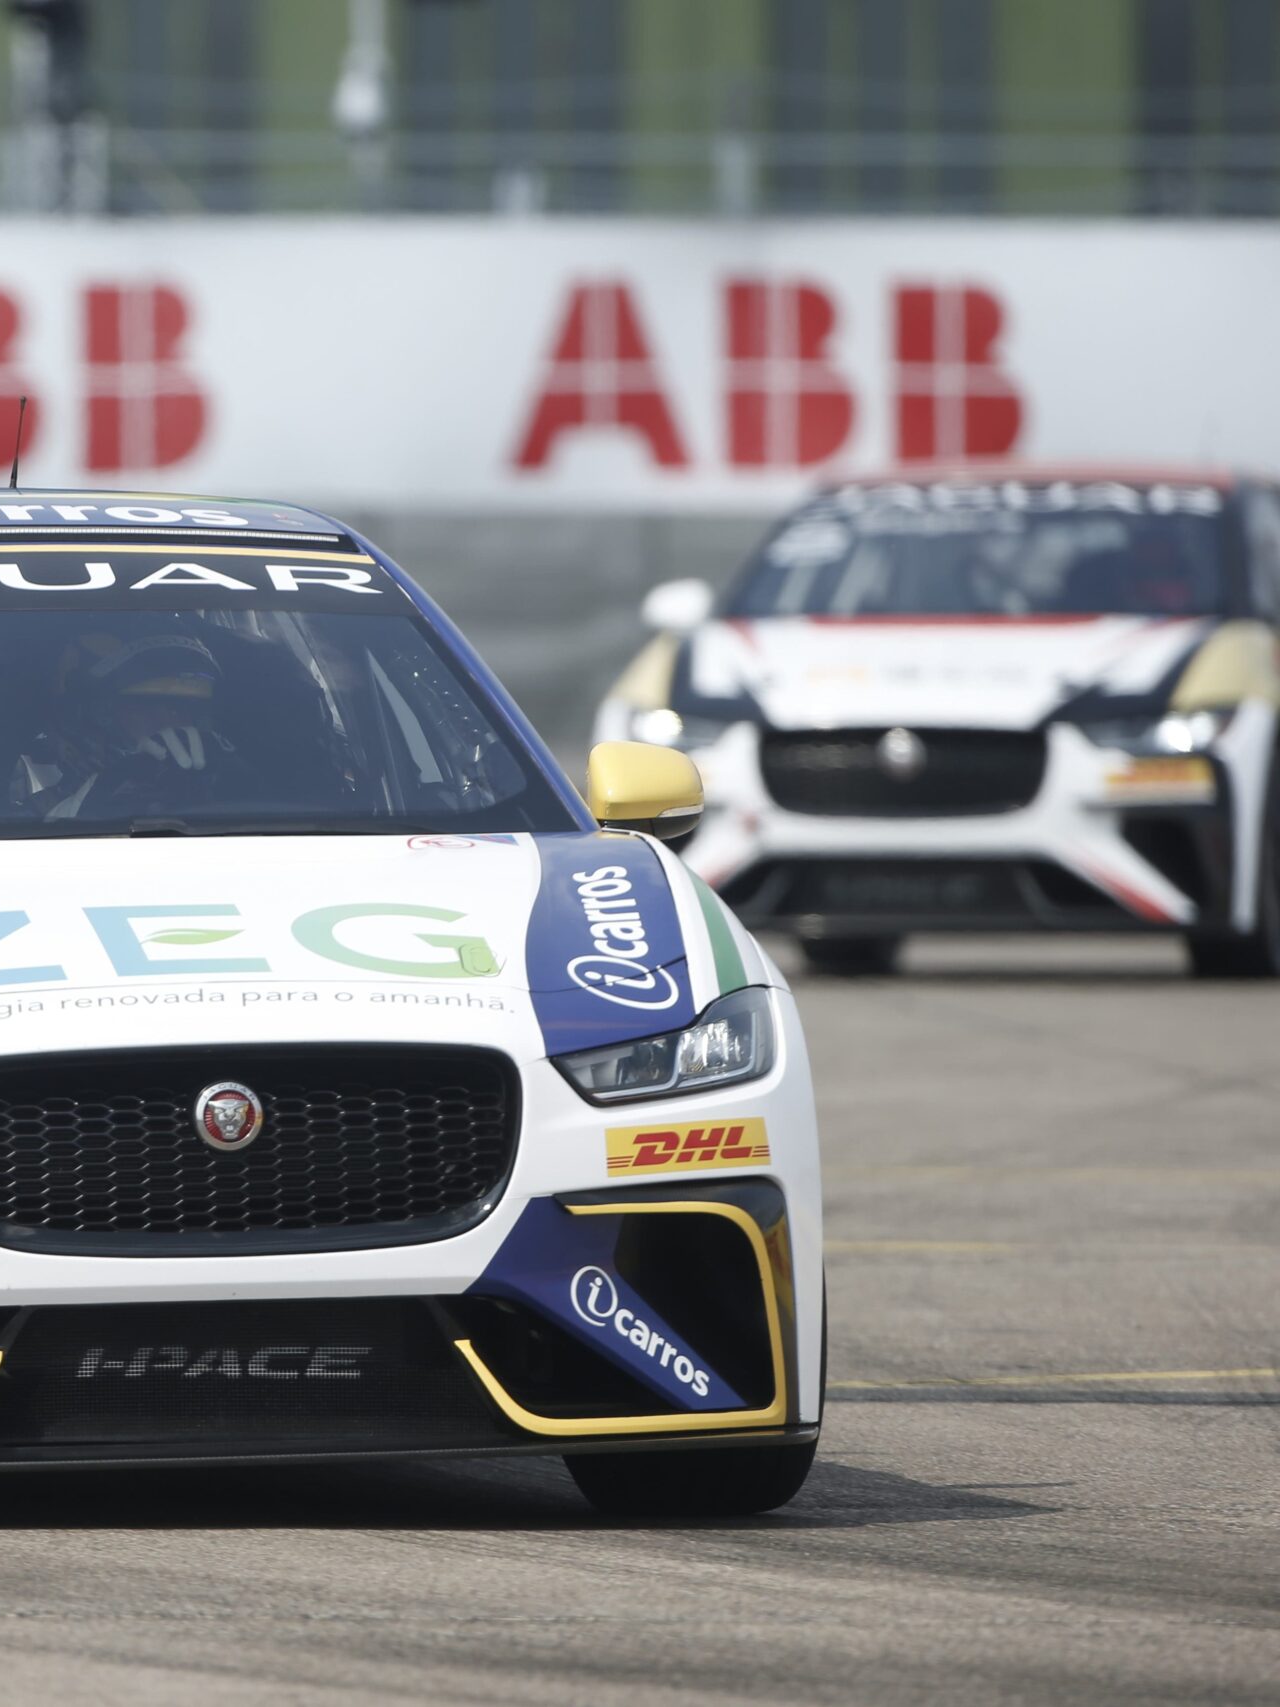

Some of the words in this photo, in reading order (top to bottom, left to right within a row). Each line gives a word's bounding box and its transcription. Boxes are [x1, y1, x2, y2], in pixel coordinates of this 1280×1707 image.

[514, 282, 1025, 468] ABB
[60, 988, 226, 1011] renovada
[241, 992, 319, 1009] para
[334, 992, 354, 1003] o
[369, 990, 517, 1014] amanhã.
[632, 1126, 753, 1167] DHL
